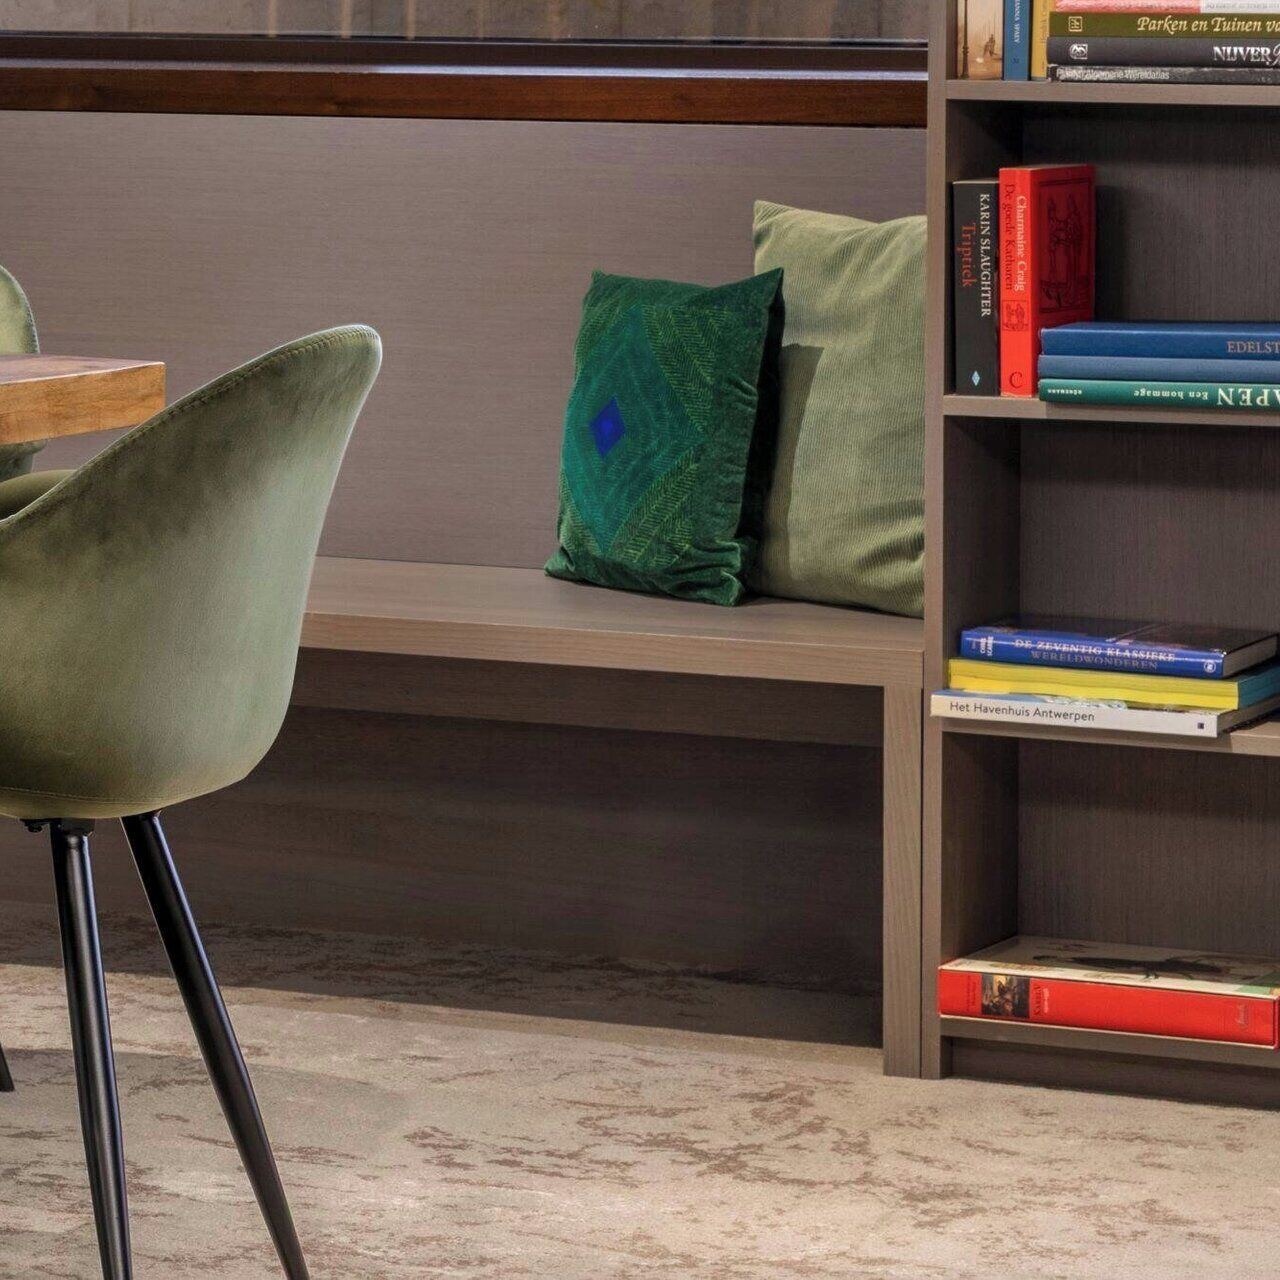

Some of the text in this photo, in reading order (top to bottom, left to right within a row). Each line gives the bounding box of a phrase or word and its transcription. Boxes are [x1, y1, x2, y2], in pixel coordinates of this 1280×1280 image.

[1012, 23, 1021, 44] SPAEY
[1137, 15, 1188, 35] Parken
[1191, 19, 1208, 32] en
[1211, 16, 1262, 33] Tuinen
[1002, 183, 1016, 292] De goede Katharen
[1014, 194, 1027, 293] Charmaine Craig
[958, 223, 976, 288] Triptiek
[979, 193, 991, 318] KARIN SLAUGHTER
[1014, 638, 1176, 663] DE ZEVENTIG KLASSIEKE
[1030, 650, 1158, 671] WERELDWONDEREN
[949, 701, 1095, 724] Het Havenhuis Antwerpen
